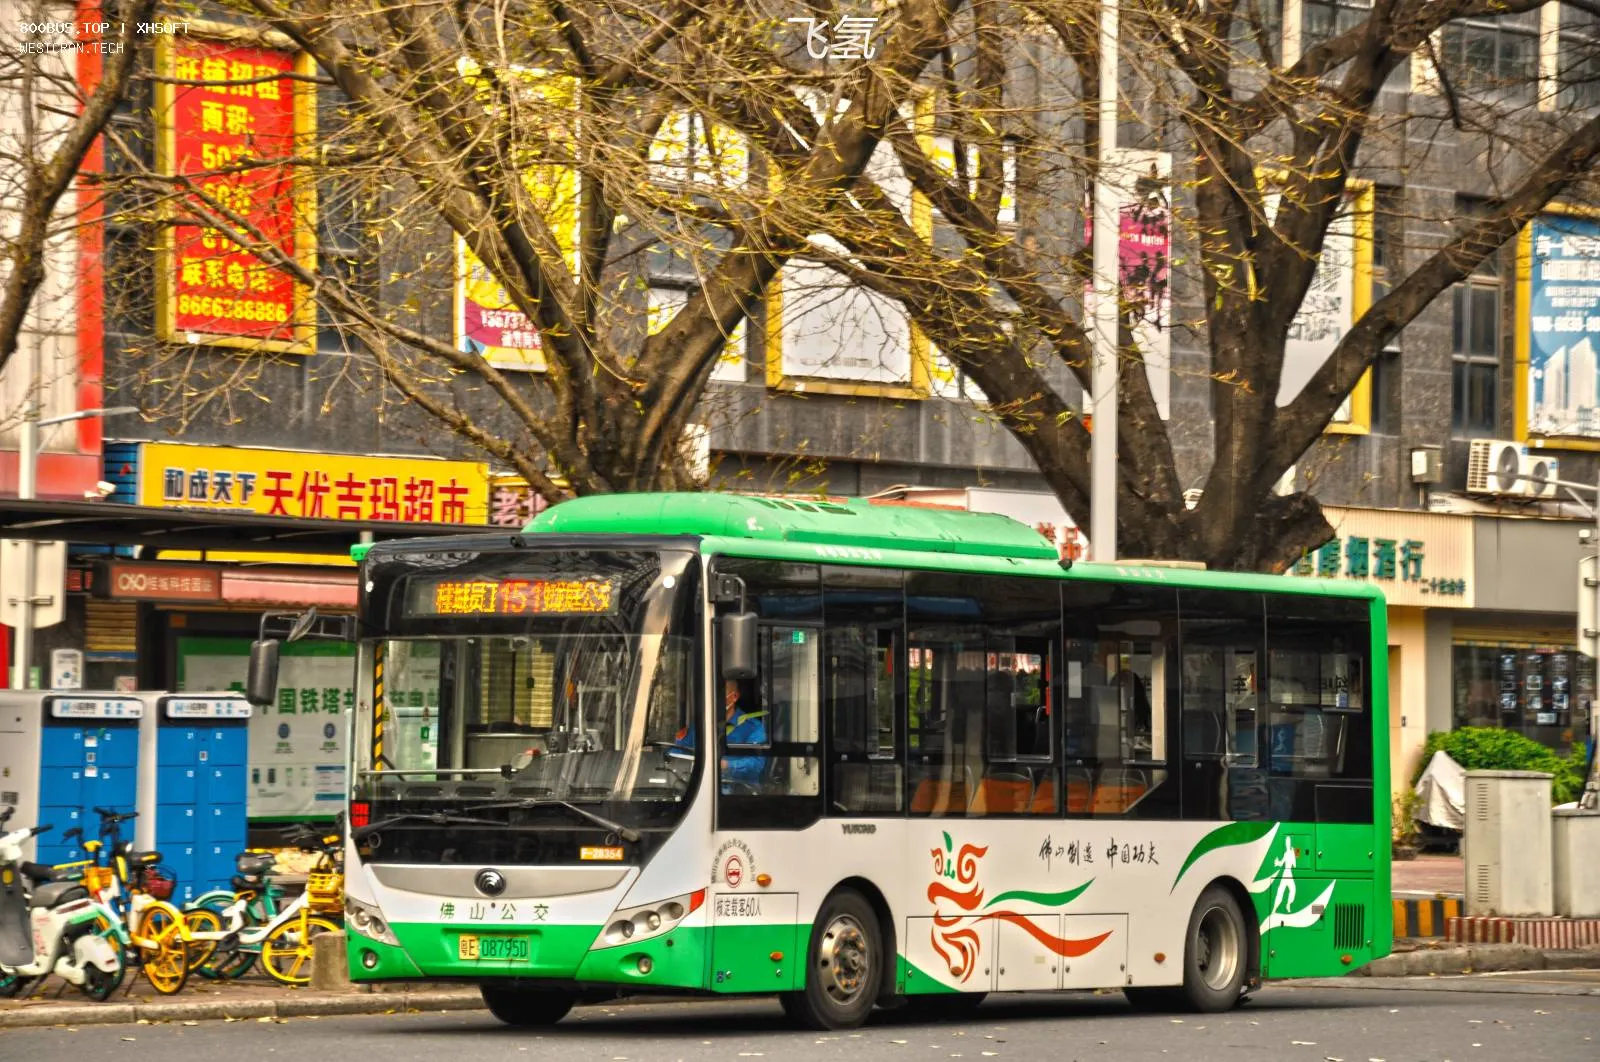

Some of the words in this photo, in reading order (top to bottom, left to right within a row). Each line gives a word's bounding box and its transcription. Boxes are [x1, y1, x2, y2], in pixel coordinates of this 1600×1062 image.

[162, 466, 257, 505] 和成天下
[263, 470, 469, 524] 天优吉玛超市
[501, 579, 541, 614] 151
[1039, 834, 1094, 873] 佛山制造
[1106, 836, 1159, 869] 中国功夫
[440, 902, 550, 922] 佛山公交
[460, 938, 477, 957] 粤E
[481, 938, 528, 958] 08795D
